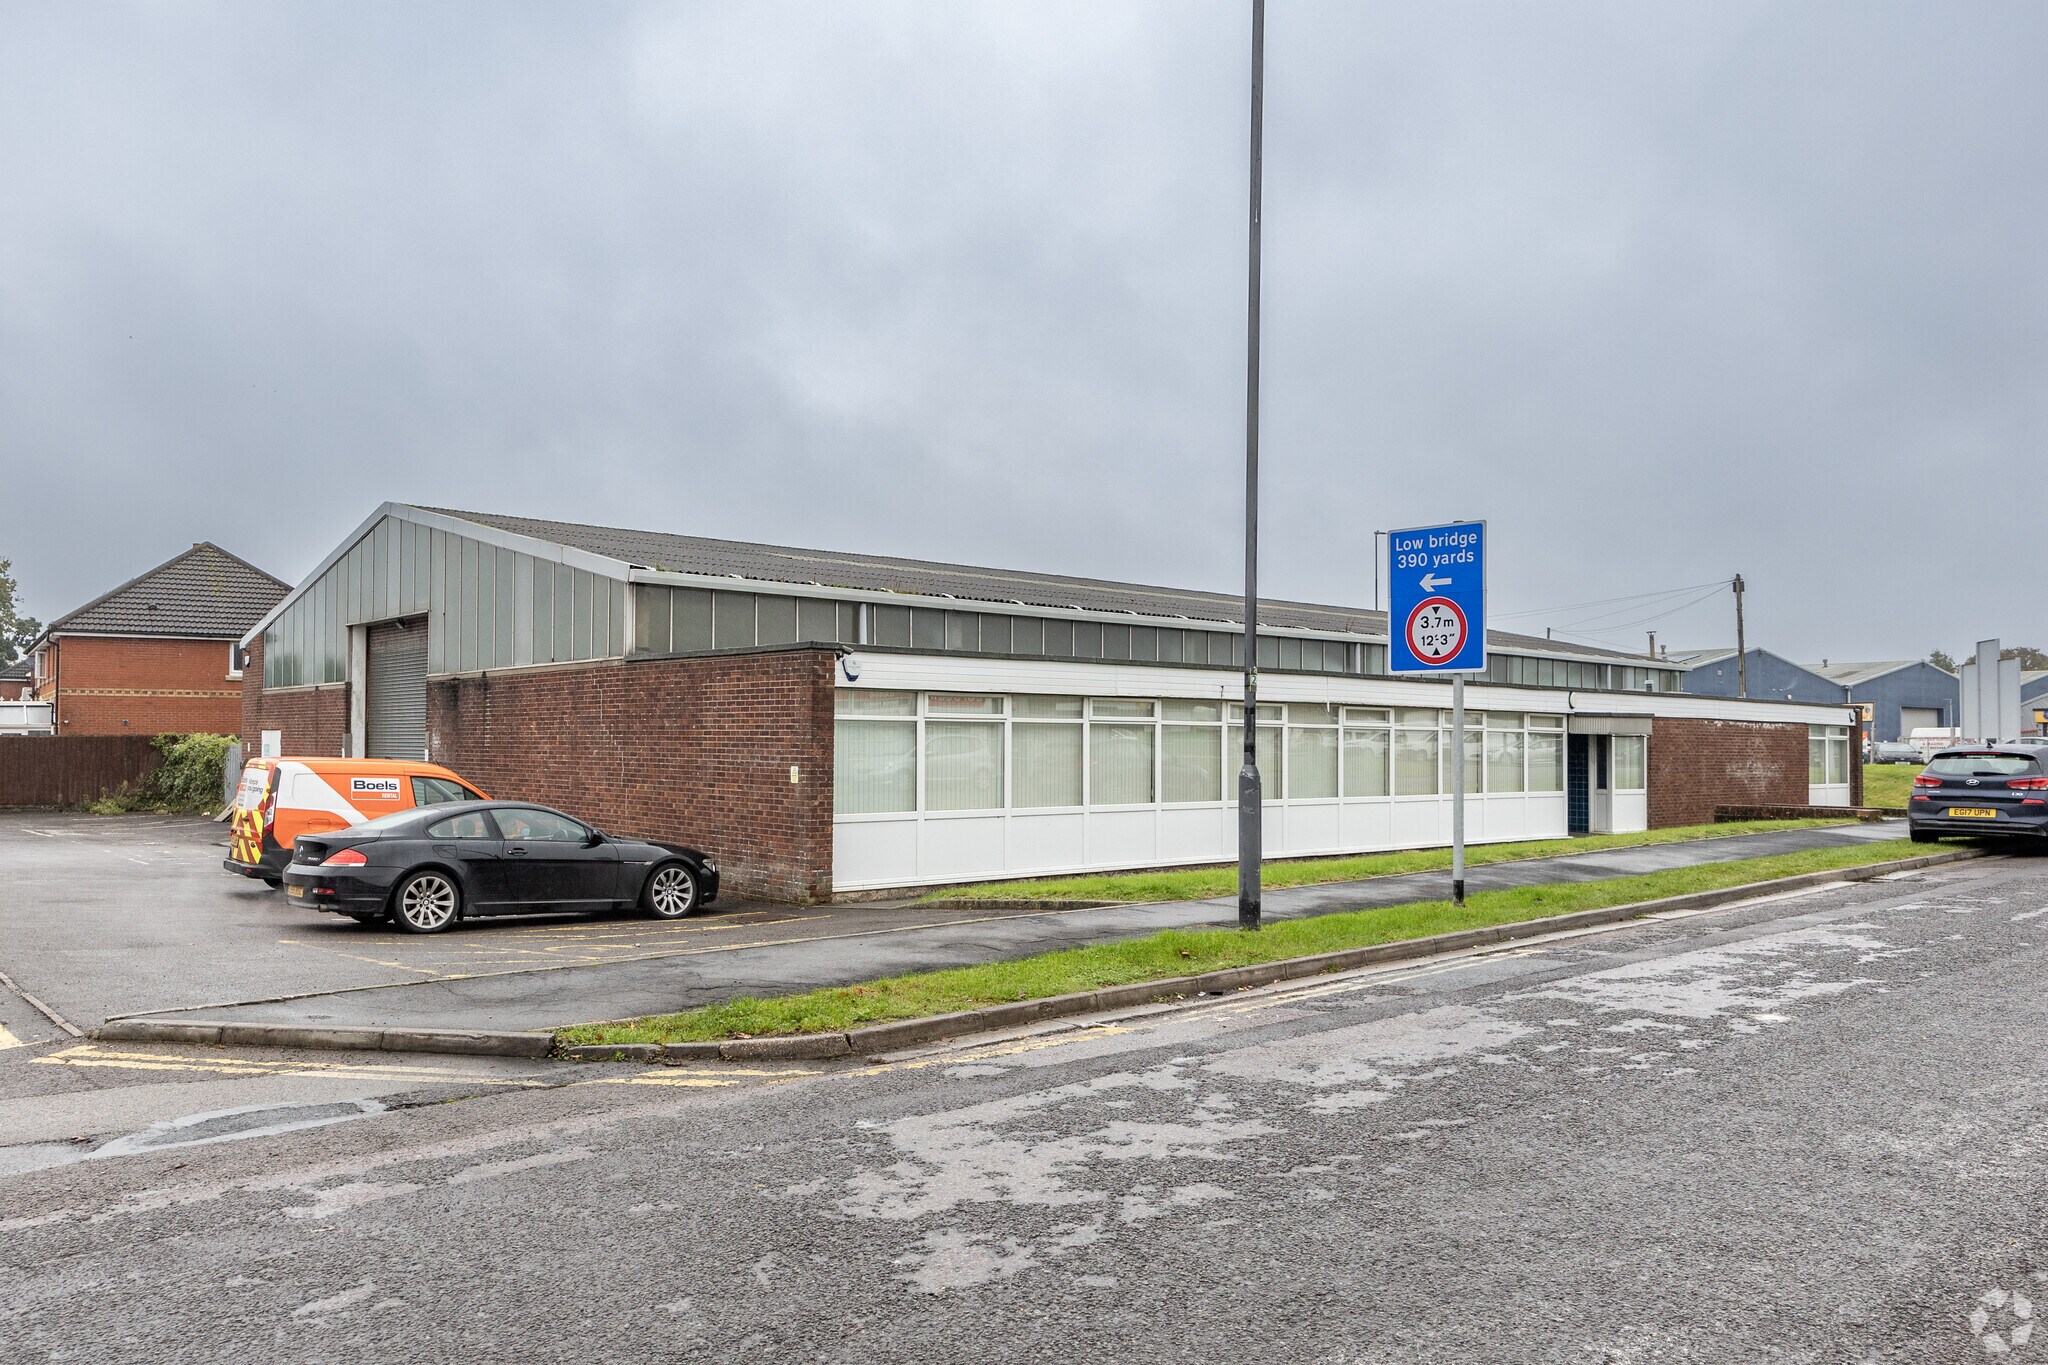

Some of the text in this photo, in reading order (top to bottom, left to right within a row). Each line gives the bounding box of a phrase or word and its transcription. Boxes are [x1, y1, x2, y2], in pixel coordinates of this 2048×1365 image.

[1395, 532, 1478, 551] Low bridge
[1397, 549, 1474, 569] 390 yards
[1420, 616, 1454, 629] 3.7m
[353, 780, 397, 790] Boels
[1953, 808, 1991, 817] EG17 UPN
